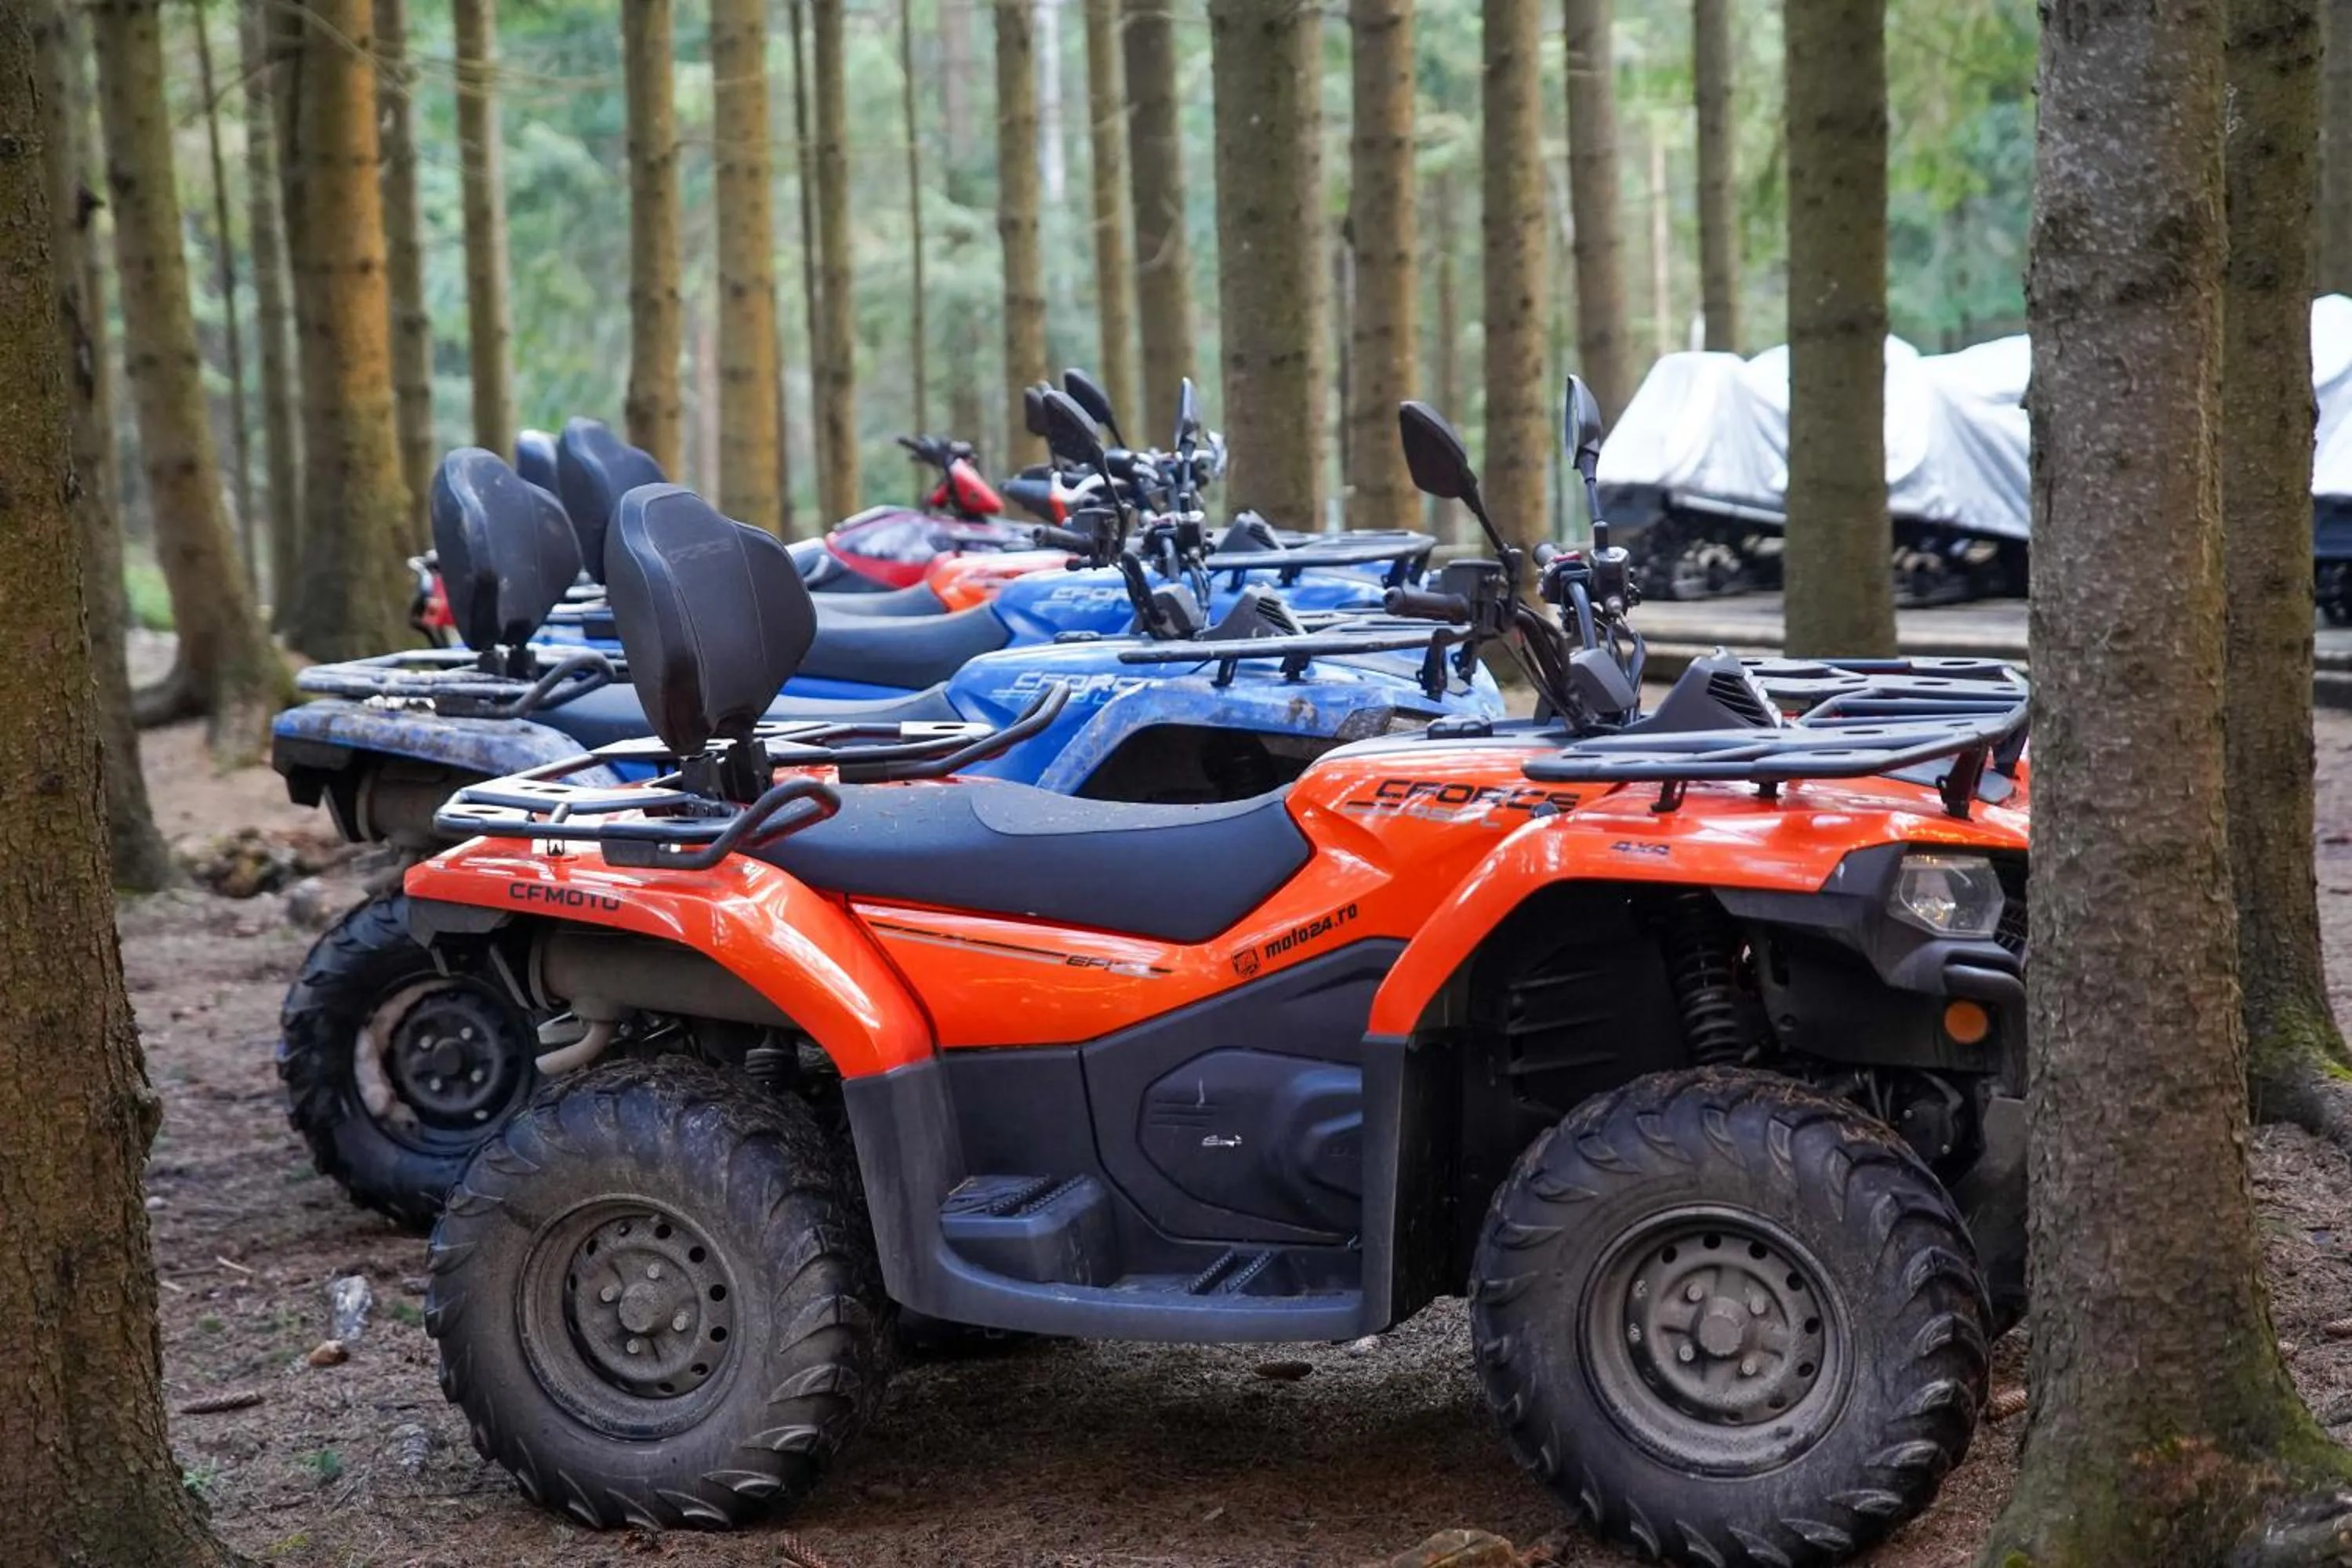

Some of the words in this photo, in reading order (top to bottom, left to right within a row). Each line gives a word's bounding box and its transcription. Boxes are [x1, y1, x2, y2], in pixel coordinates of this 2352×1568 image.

[1375, 778, 1581, 812] CFORCE
[510, 881, 621, 911] CFMOTO
[1265, 902, 1358, 959] moto24.ro
